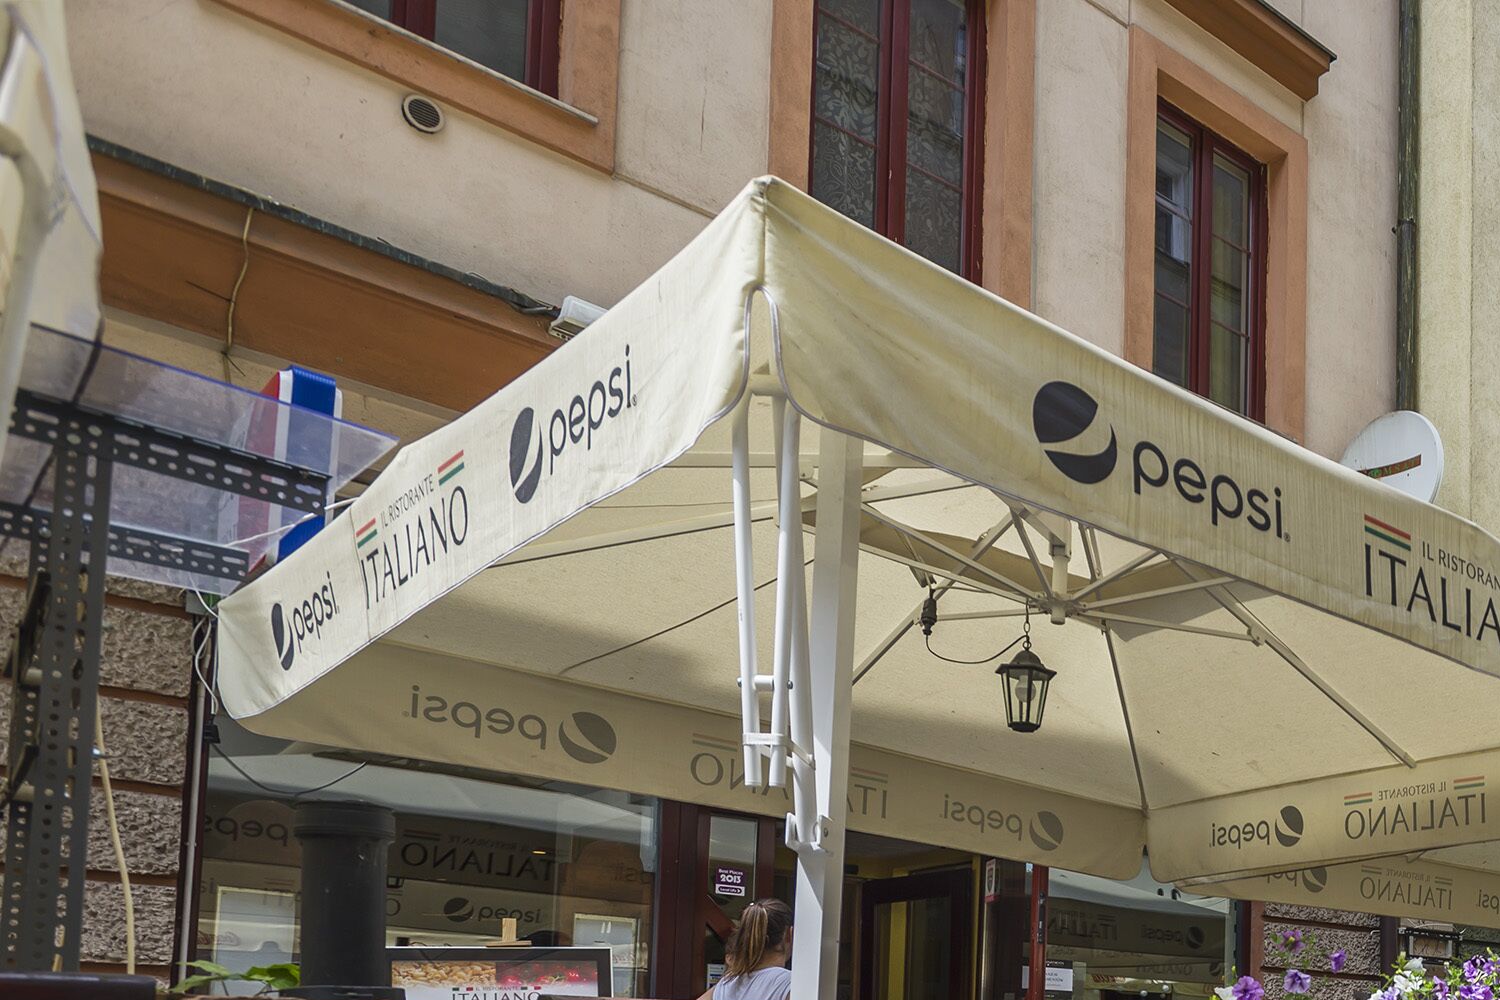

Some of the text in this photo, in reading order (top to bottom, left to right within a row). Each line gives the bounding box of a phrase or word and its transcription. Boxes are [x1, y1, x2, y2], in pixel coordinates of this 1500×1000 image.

[549, 344, 633, 475] pepsi
[380, 473, 434, 529] IL RISTORANTE
[1133, 440, 1285, 538] pepsi
[361, 486, 468, 610] ITALIANO
[1422, 541, 1434, 561] IL
[293, 571, 338, 653] pepsi
[720, 874, 741, 884] 2013
